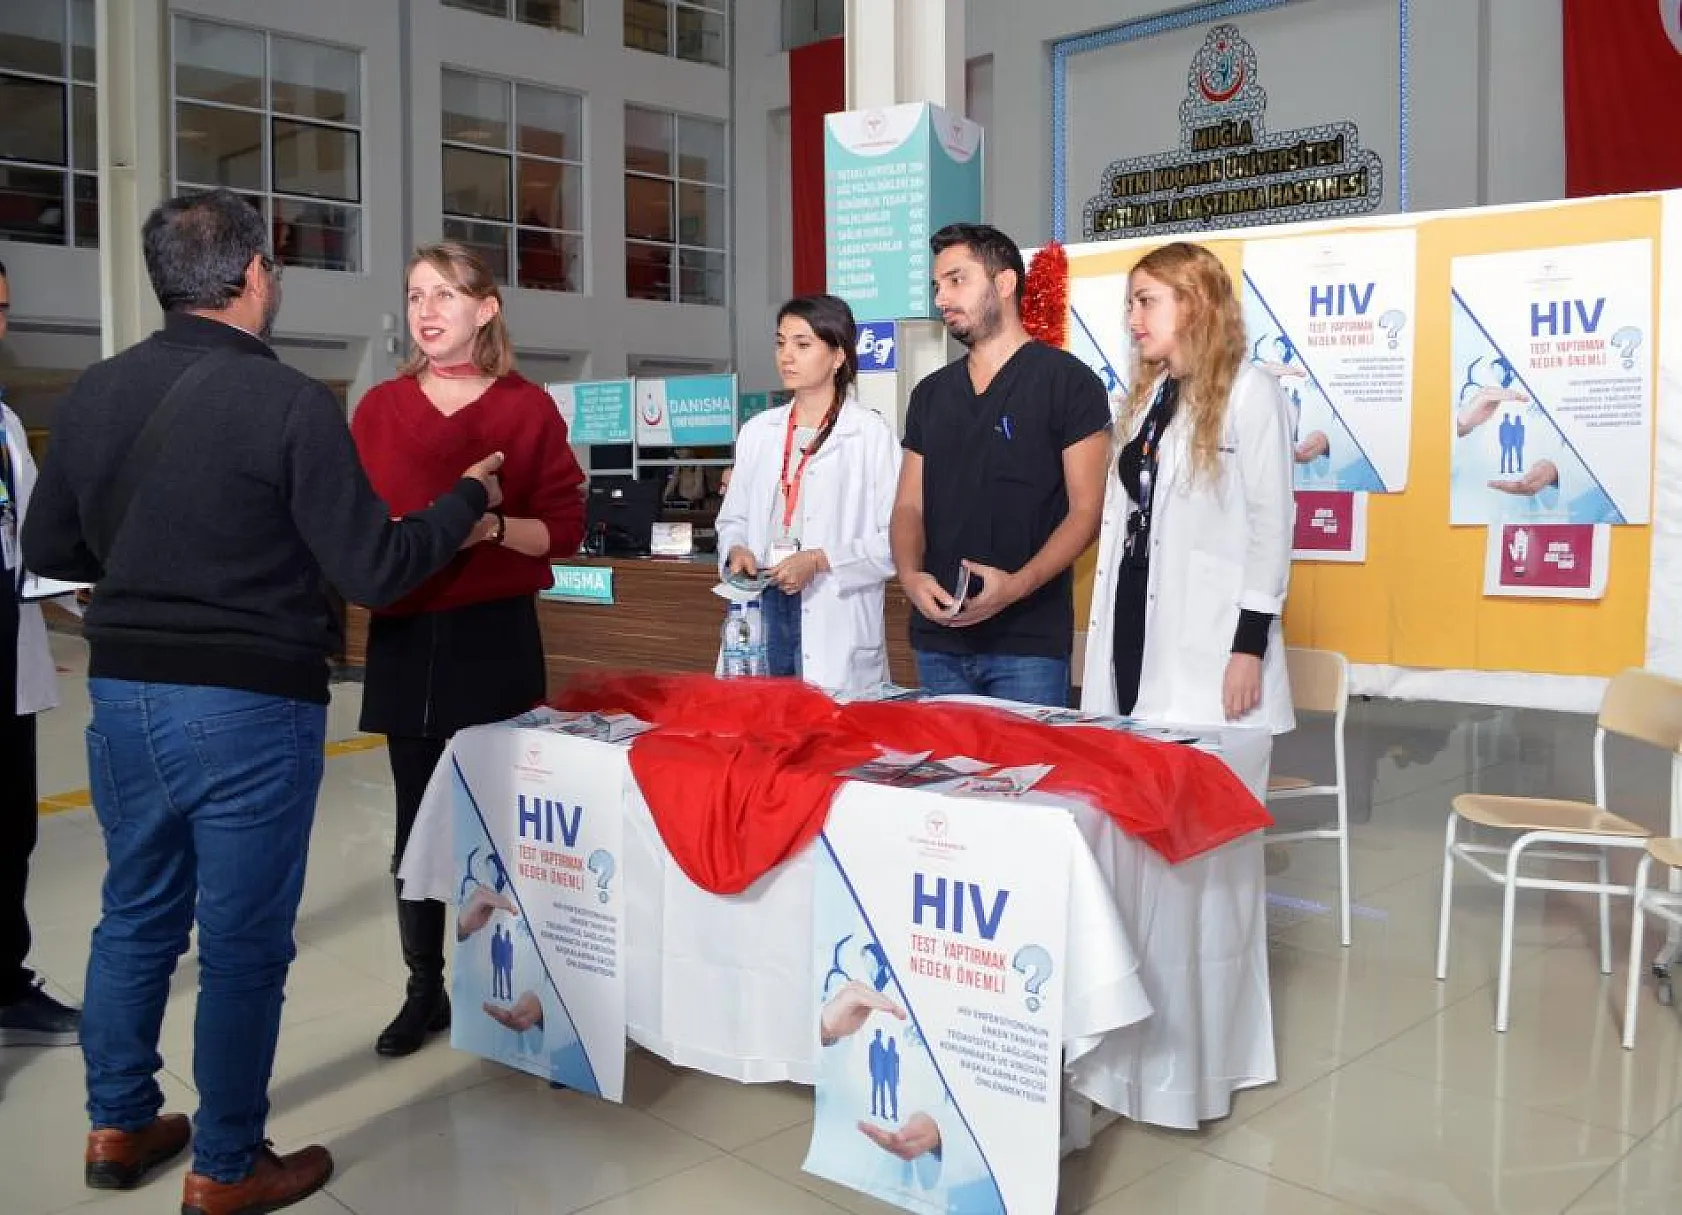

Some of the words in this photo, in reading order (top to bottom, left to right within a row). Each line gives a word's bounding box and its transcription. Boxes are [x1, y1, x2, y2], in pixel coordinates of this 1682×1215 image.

[1191, 119, 1252, 152] MUĞLA
[1268, 166, 1368, 208] HASTANESİ
[1310, 283, 1375, 316] HIV
[1531, 298, 1606, 336] HIV
[519, 795, 582, 847] HIV
[913, 873, 1009, 940] HIV
[911, 956, 952, 982] NEDEN
[912, 935, 937, 955] TEST
[943, 940, 1007, 971] YAPTIRMAK
